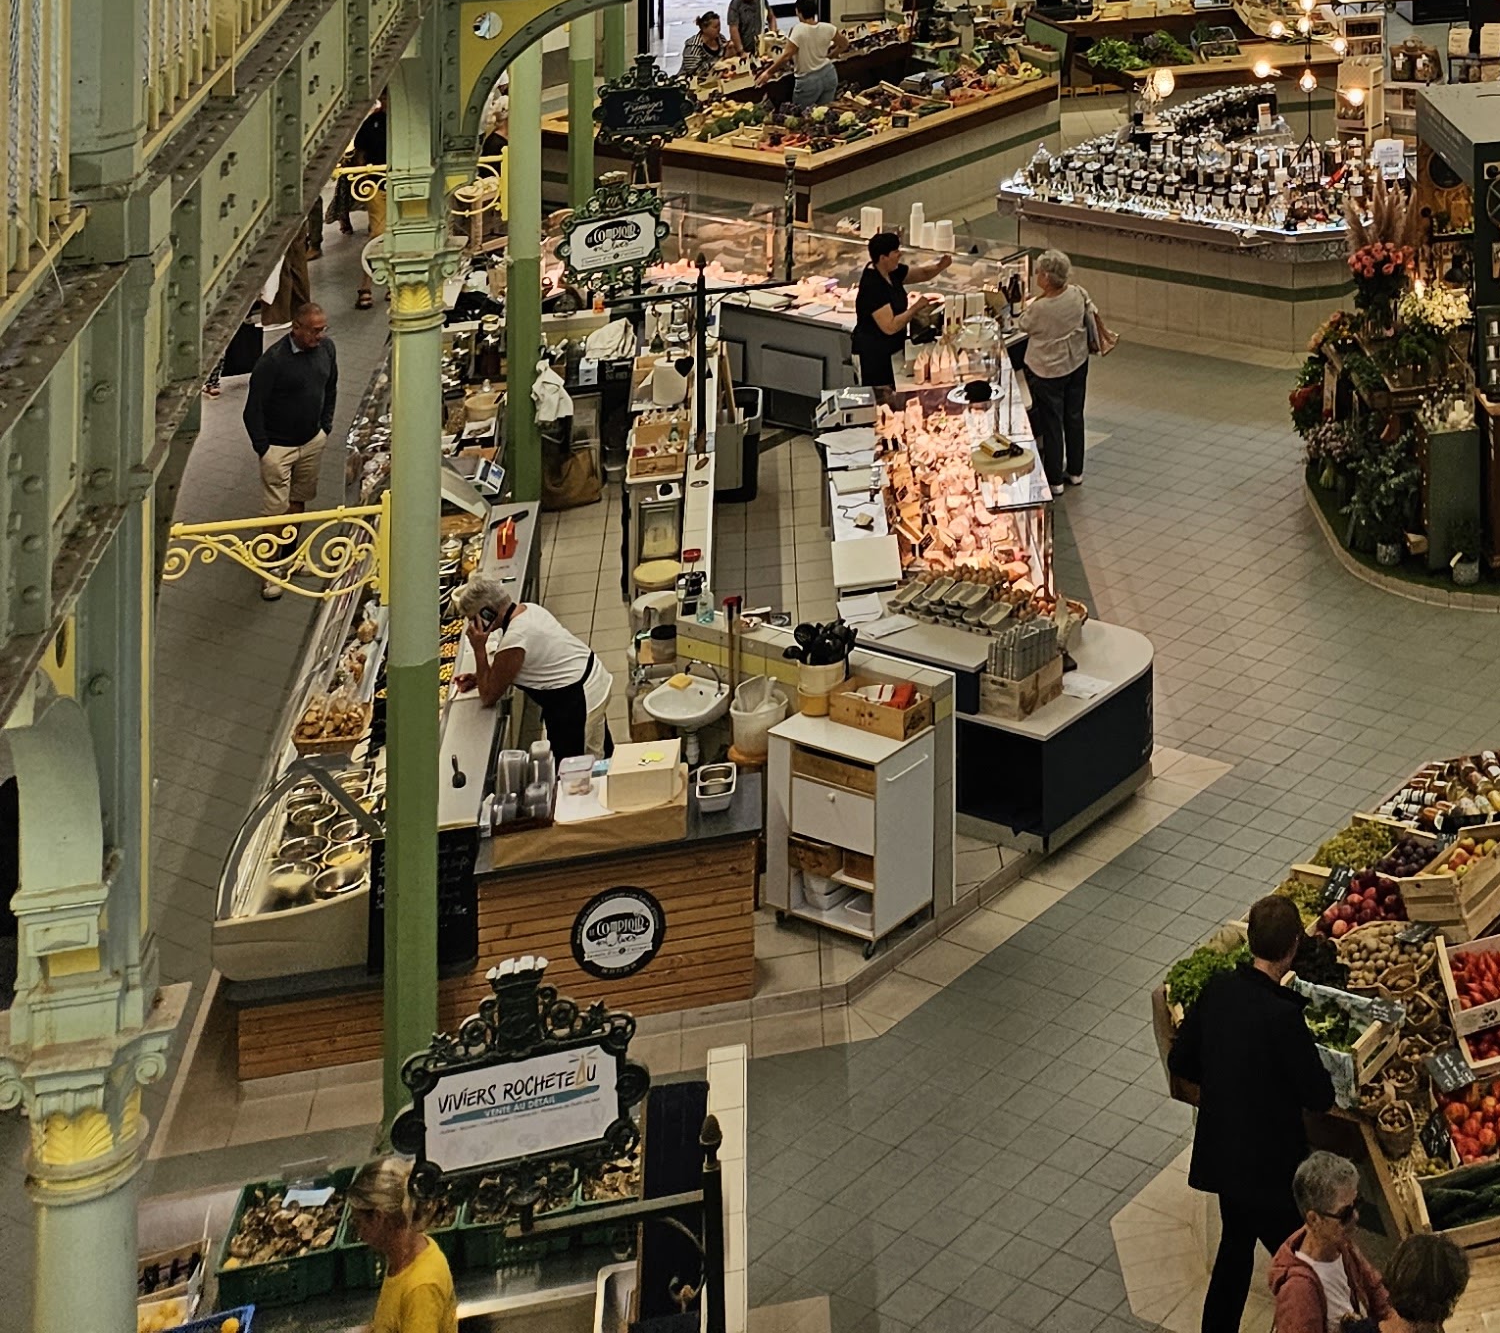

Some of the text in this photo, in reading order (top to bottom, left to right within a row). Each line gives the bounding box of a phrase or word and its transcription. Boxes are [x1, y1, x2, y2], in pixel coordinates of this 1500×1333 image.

[597, 917, 646, 936] COMPTOIR
[438, 1084, 496, 1114] VIVIERS
[503, 1055, 597, 1101] ROCHETEAU
[484, 1105, 511, 1117] VENTE
[513, 1102, 526, 1111] AU
[528, 1096, 556, 1109] DÉTAIL
